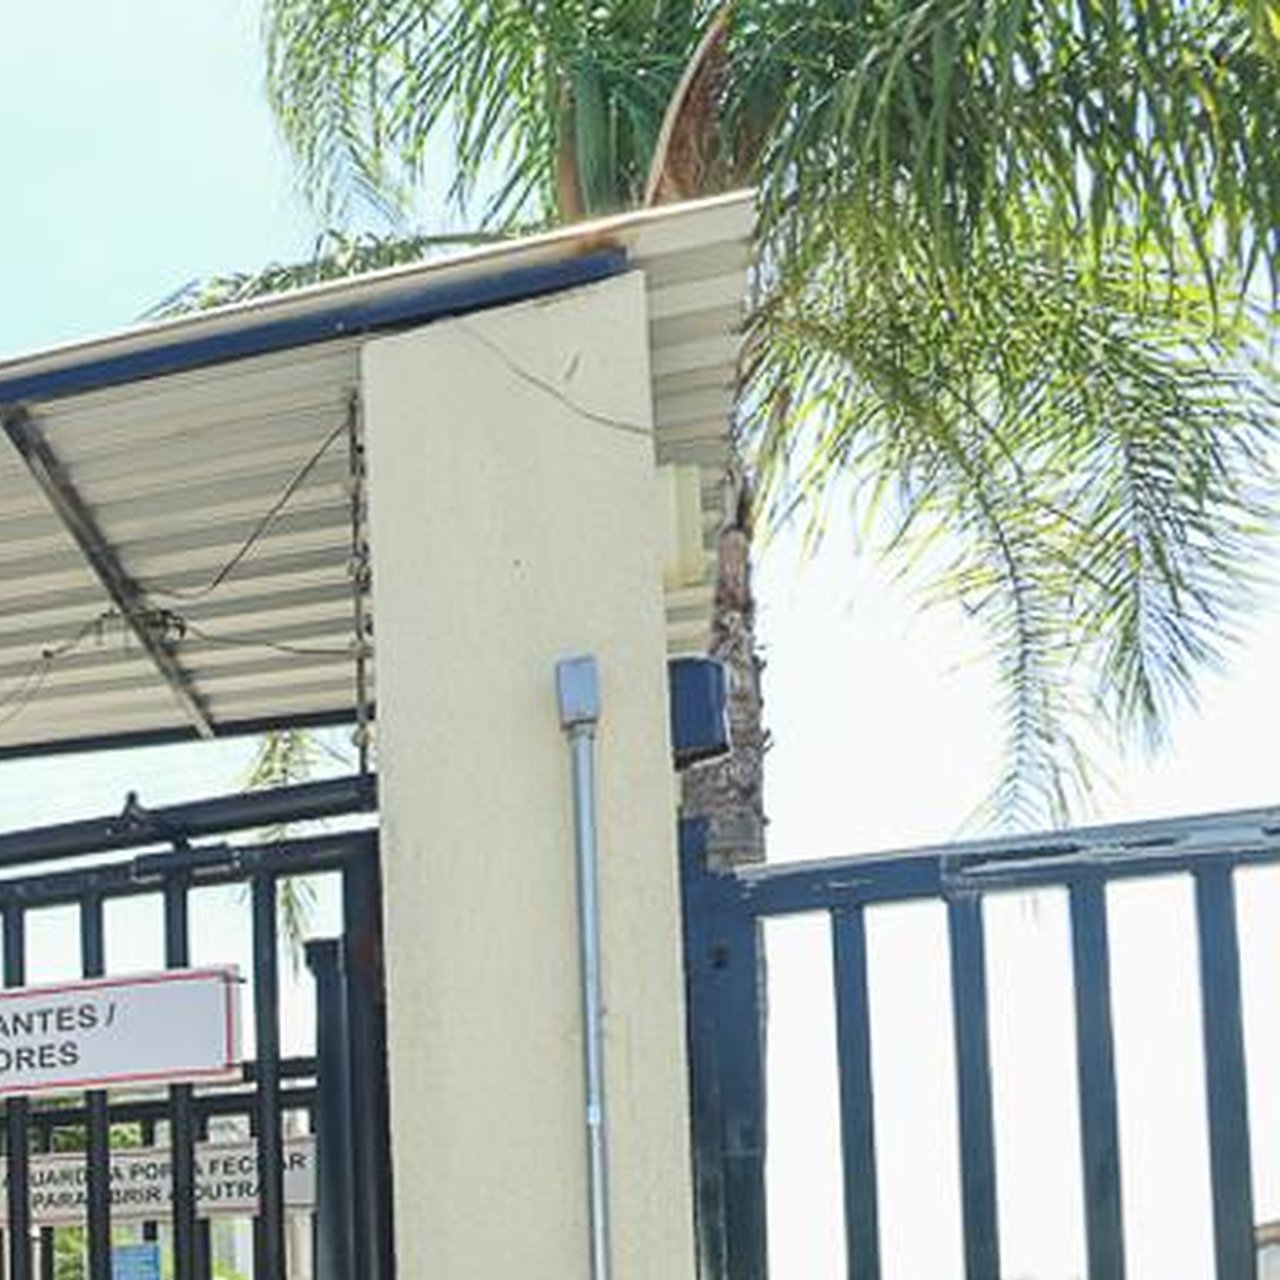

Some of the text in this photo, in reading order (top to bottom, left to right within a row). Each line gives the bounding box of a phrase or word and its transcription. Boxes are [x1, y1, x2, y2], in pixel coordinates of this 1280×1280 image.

[105, 1002, 116, 1027] /
[208, 1153, 306, 1175] FECR
[190, 1180, 271, 1201] OUTR
